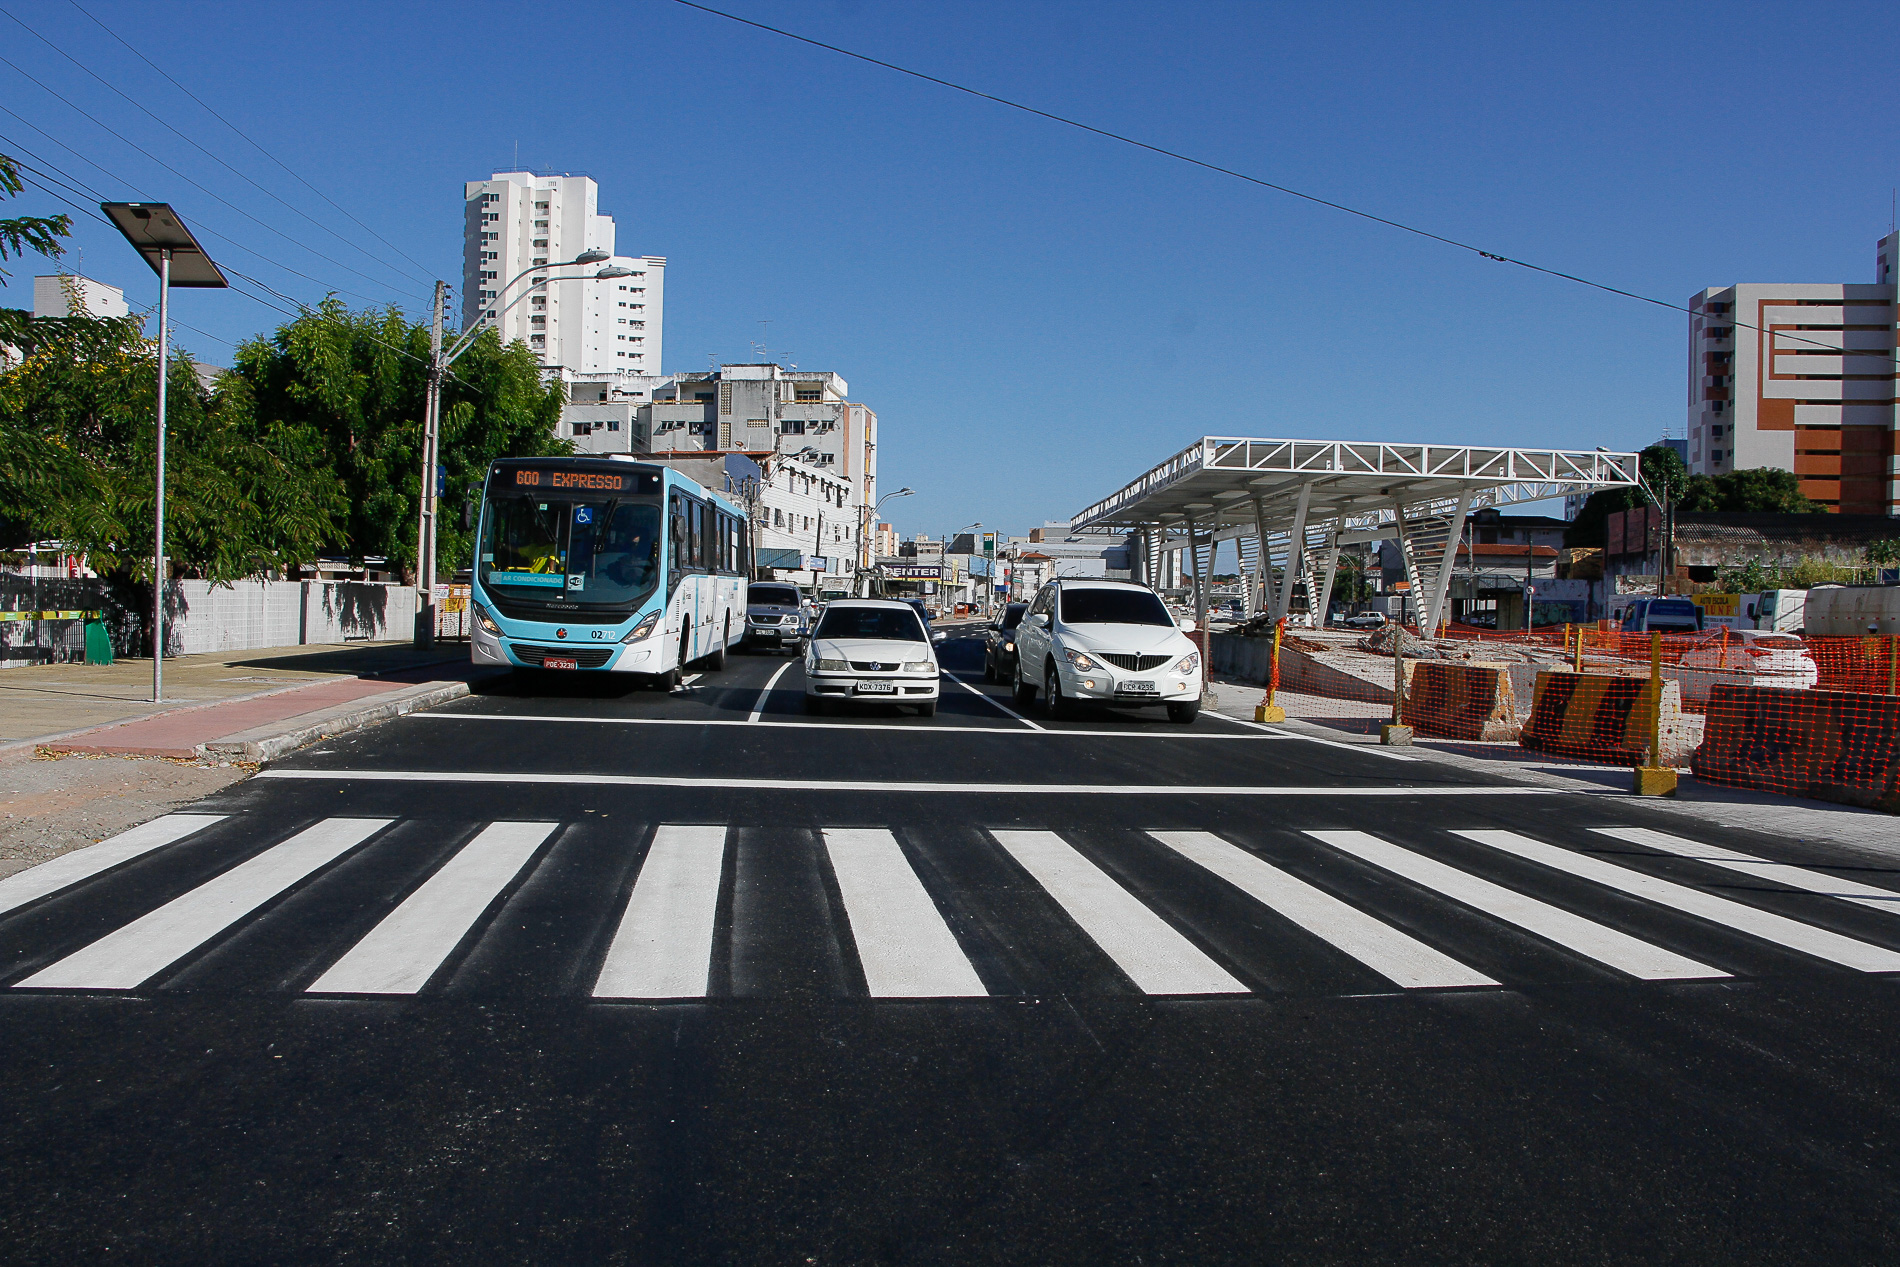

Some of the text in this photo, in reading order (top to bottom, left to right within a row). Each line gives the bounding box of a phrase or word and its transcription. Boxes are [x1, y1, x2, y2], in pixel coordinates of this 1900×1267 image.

[516, 470, 623, 490] 600 EXPRESSO
[512, 575, 563, 584] CONDICIONADO
[1700, 597, 1729, 605] AUTO ESCOLA
[1704, 604, 1738, 616] IUNFO
[591, 630, 616, 640] 02712
